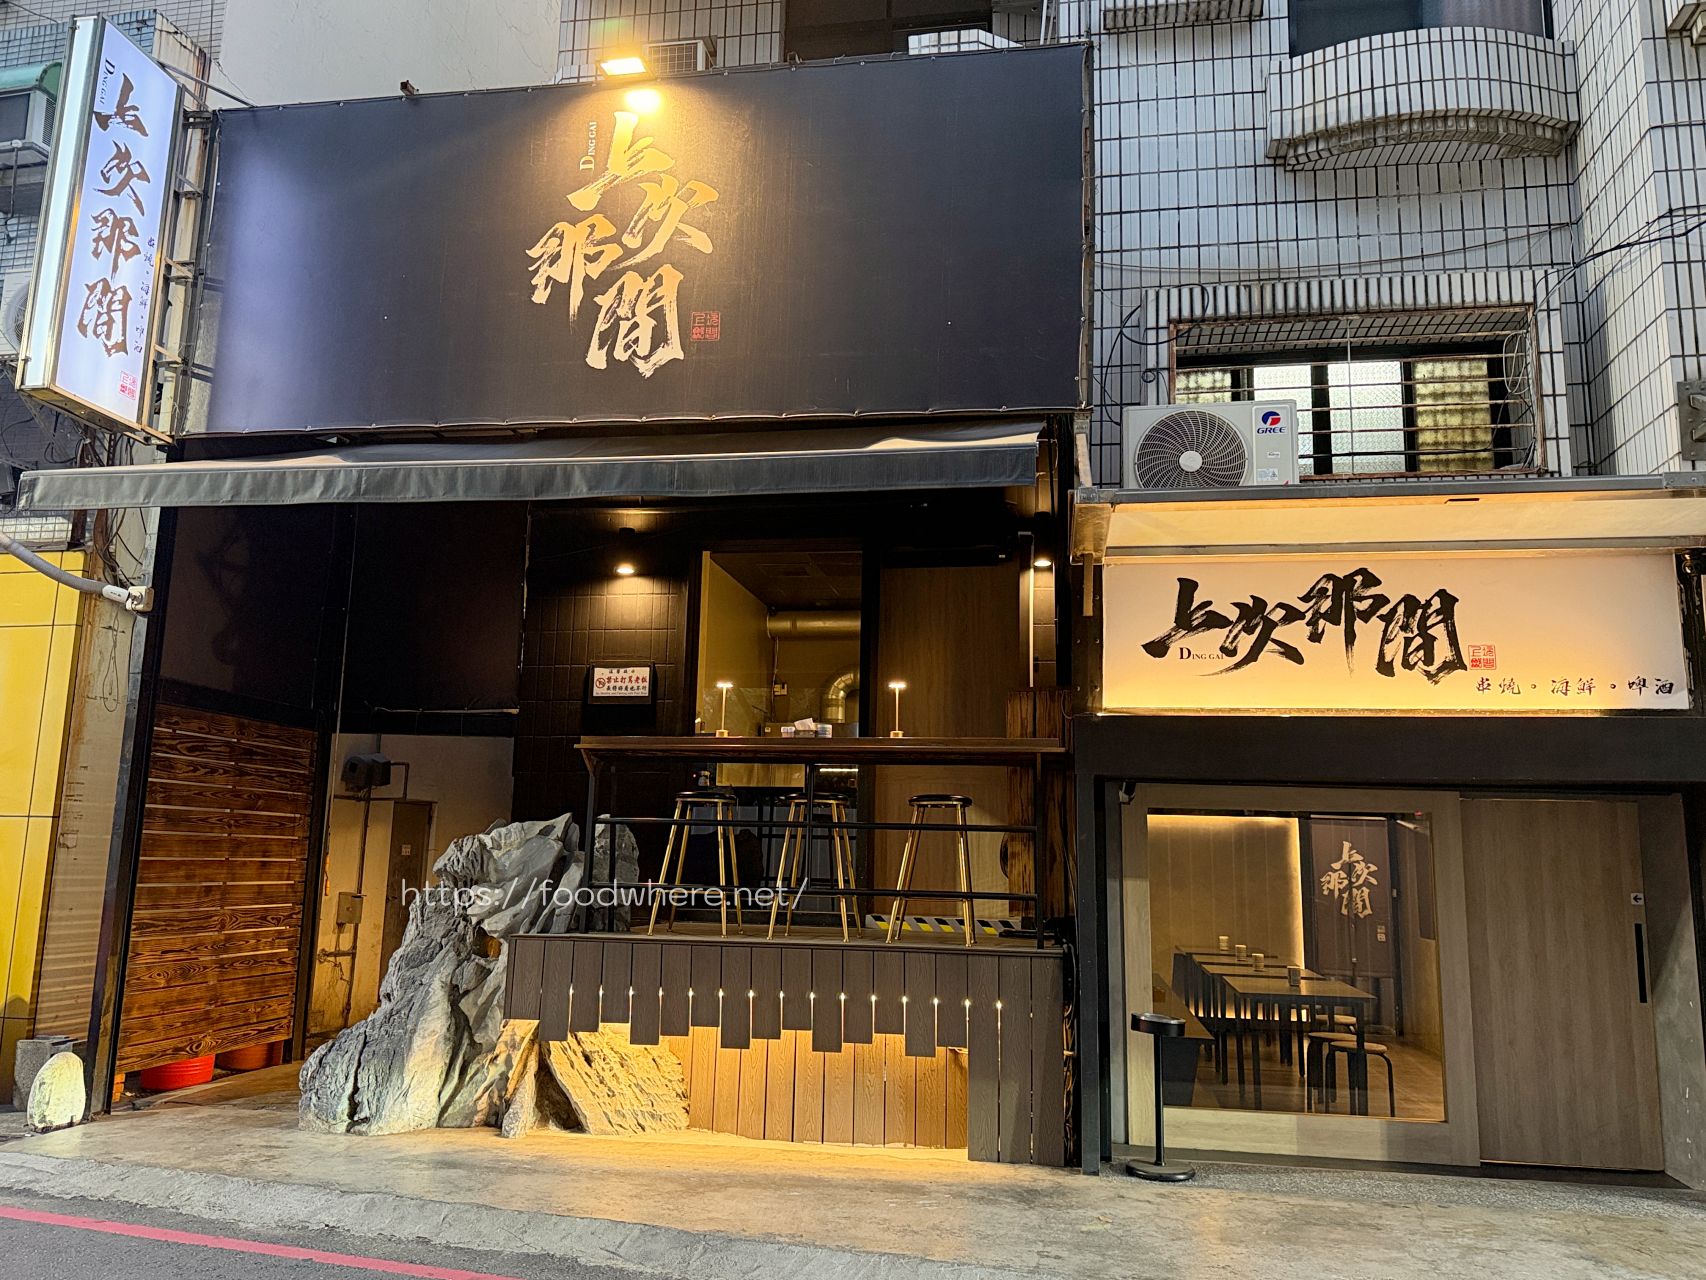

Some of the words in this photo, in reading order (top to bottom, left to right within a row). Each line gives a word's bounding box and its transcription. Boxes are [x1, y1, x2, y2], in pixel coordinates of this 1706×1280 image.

[580, 139, 596, 171] DING
[588, 121, 596, 138] GAI
[77, 73, 151, 357] 上次那間
[526, 112, 719, 378] 上次那間
[1142, 567, 1469, 684] 上次那間
[1179, 646, 1206, 660] DING
[1320, 841, 1378, 918] 上次那間
